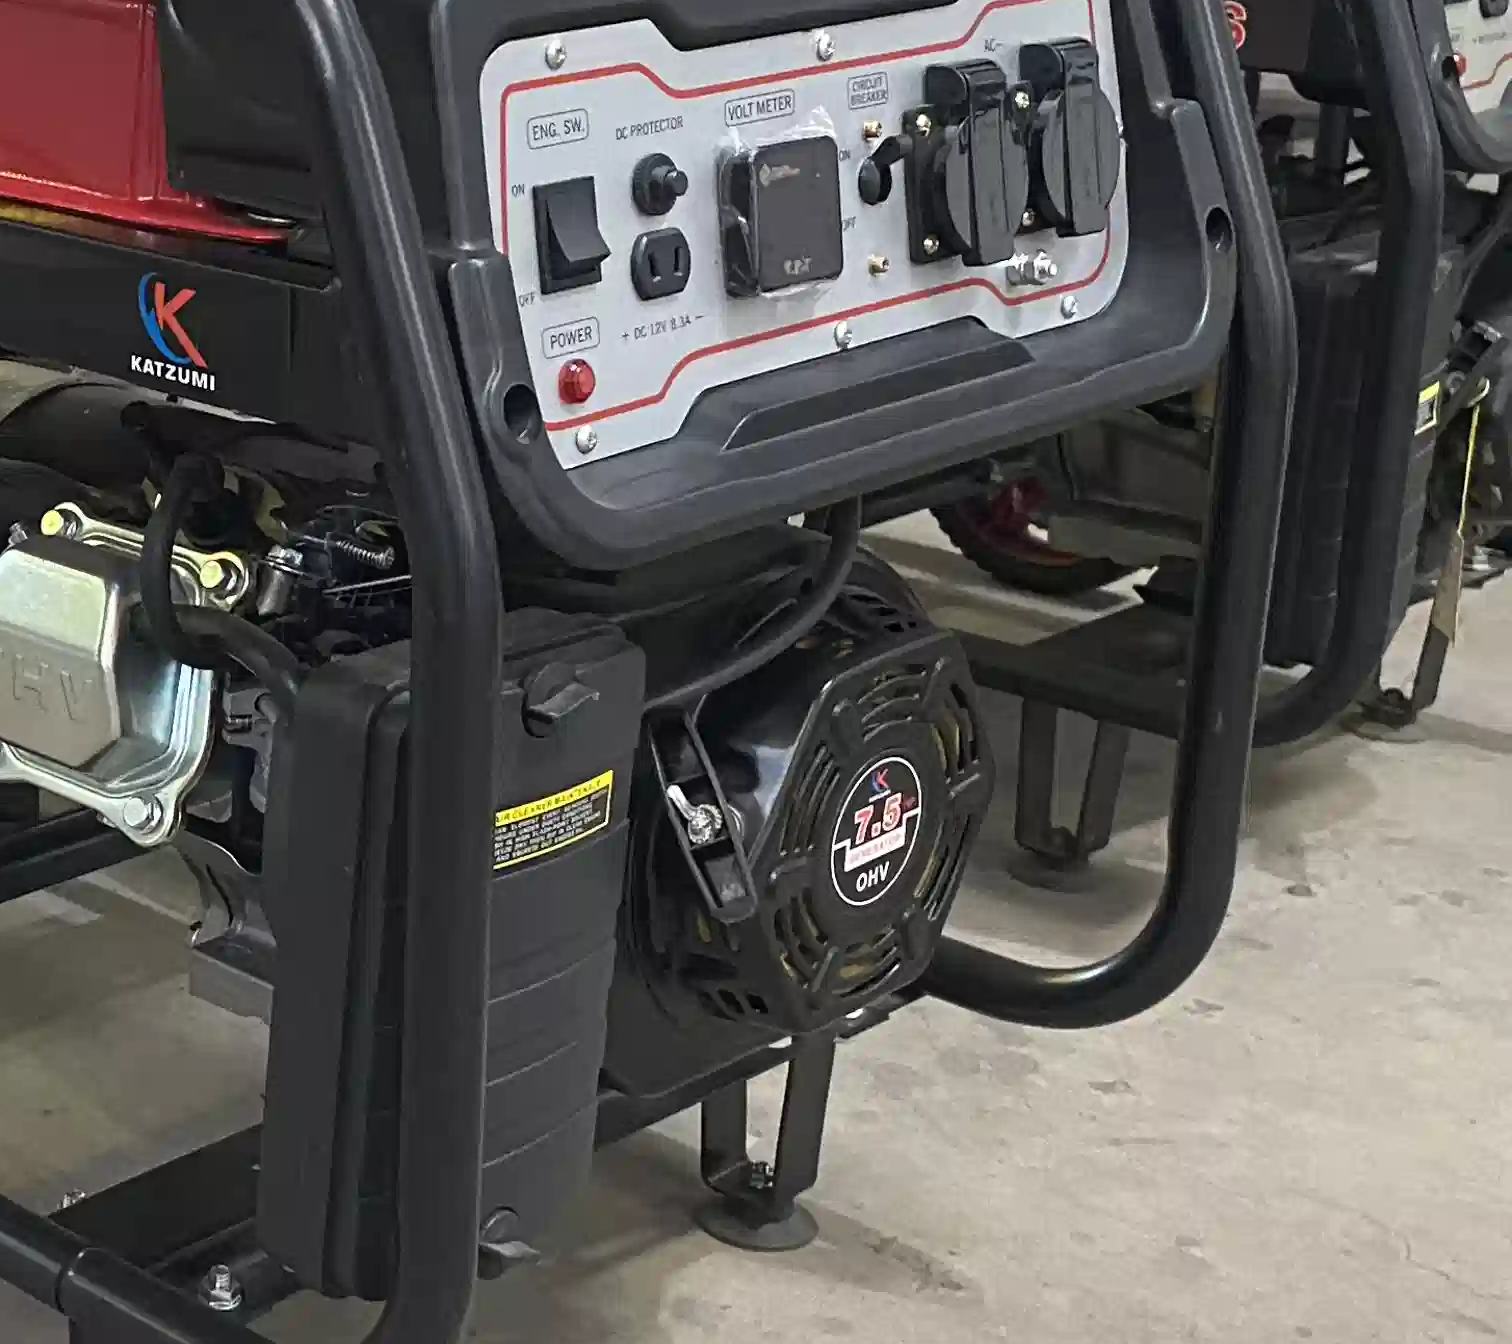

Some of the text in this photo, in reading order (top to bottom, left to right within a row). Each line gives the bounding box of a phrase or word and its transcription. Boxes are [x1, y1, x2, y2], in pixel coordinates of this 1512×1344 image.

[727, 94, 792, 121] VOLT METER
[563, 116, 586, 136] SW.
[615, 115, 684, 141] DC PROTECTOR
[511, 183, 526, 197] ON
[549, 325, 593, 350] POWER
[633, 326, 648, 341] DC
[130, 354, 216, 392] KATZUMI
[854, 791, 903, 846] 7.5
[855, 860, 890, 893] OHV
